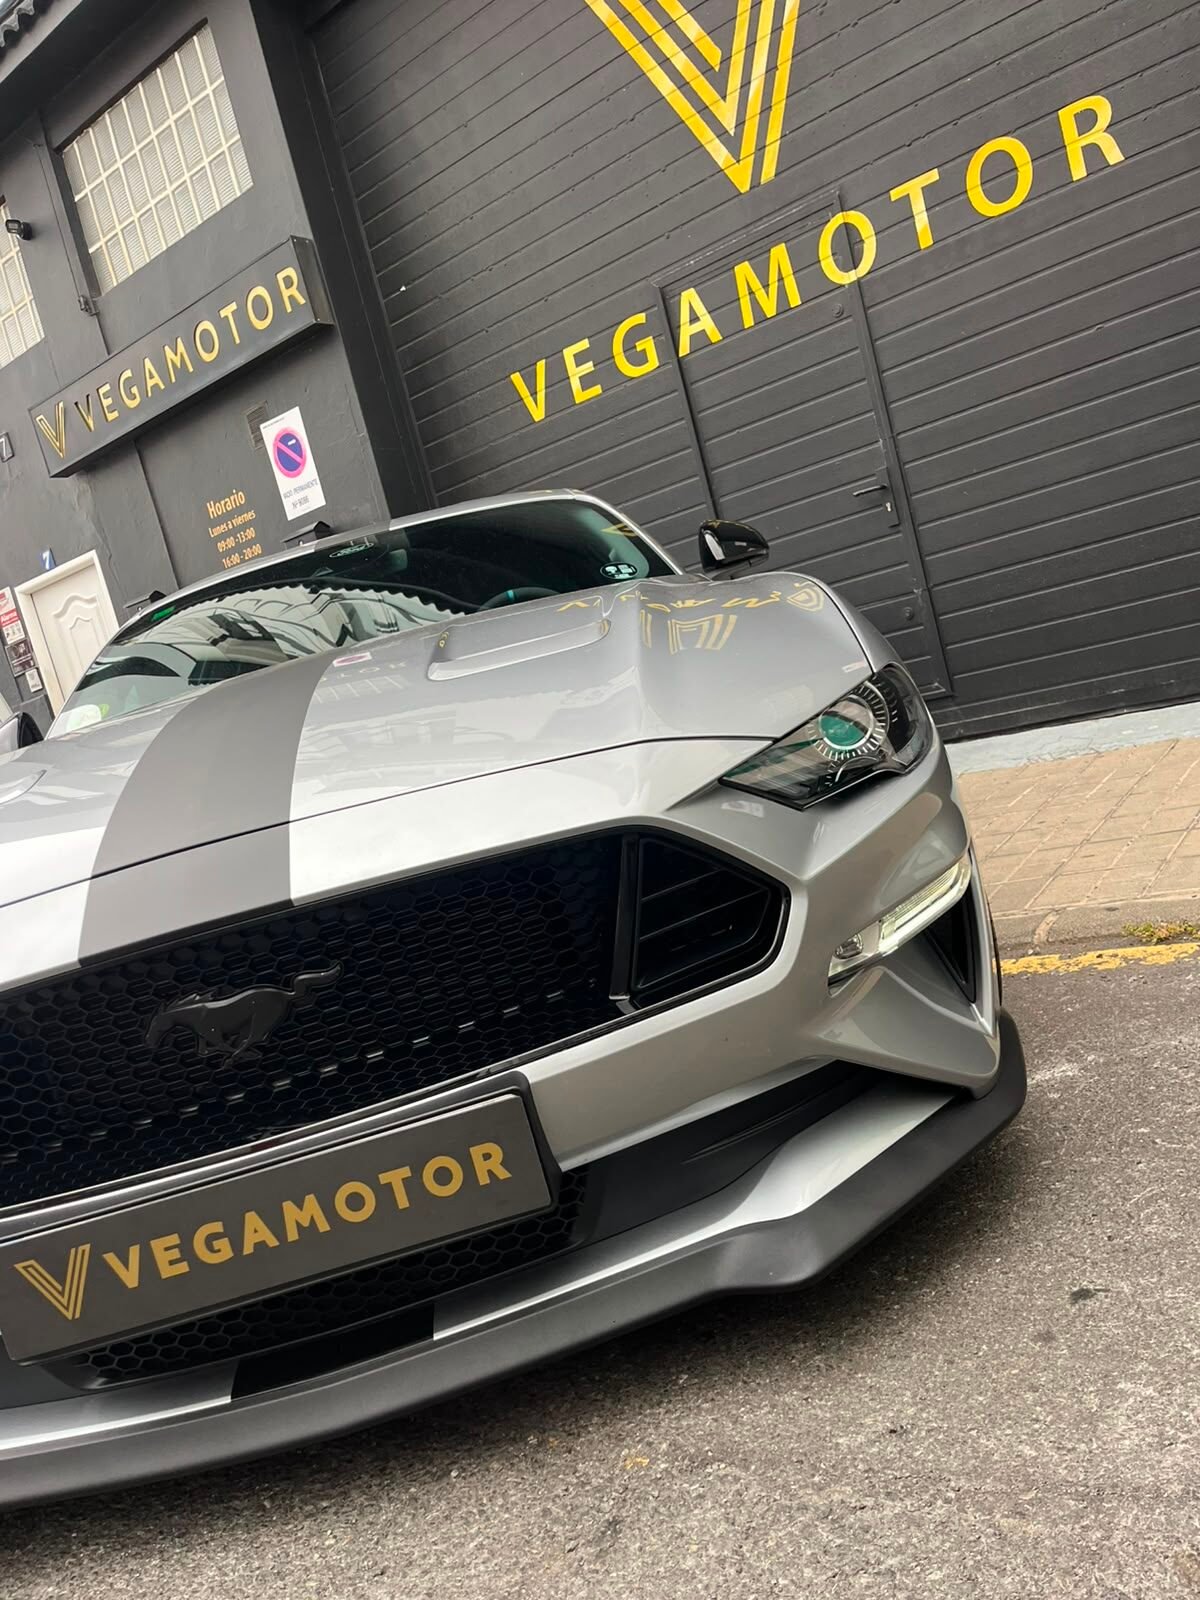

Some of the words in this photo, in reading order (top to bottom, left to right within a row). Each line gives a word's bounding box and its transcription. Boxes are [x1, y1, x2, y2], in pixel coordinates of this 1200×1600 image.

[508, 94, 1125, 424] VEGAMOTOR
[75, 266, 306, 432] VEGAMOTOR
[206, 488, 246, 519] Horario
[208, 522, 228, 538] Lunes
[231, 509, 256, 527] viernes
[217, 536, 235, 552] 09:00
[222, 553, 240, 568] 16:00
[244, 543, 262, 560] 20:00
[42, 551, 51, 569] 7
[102, 1142, 512, 1289] VEGAMOTOR
